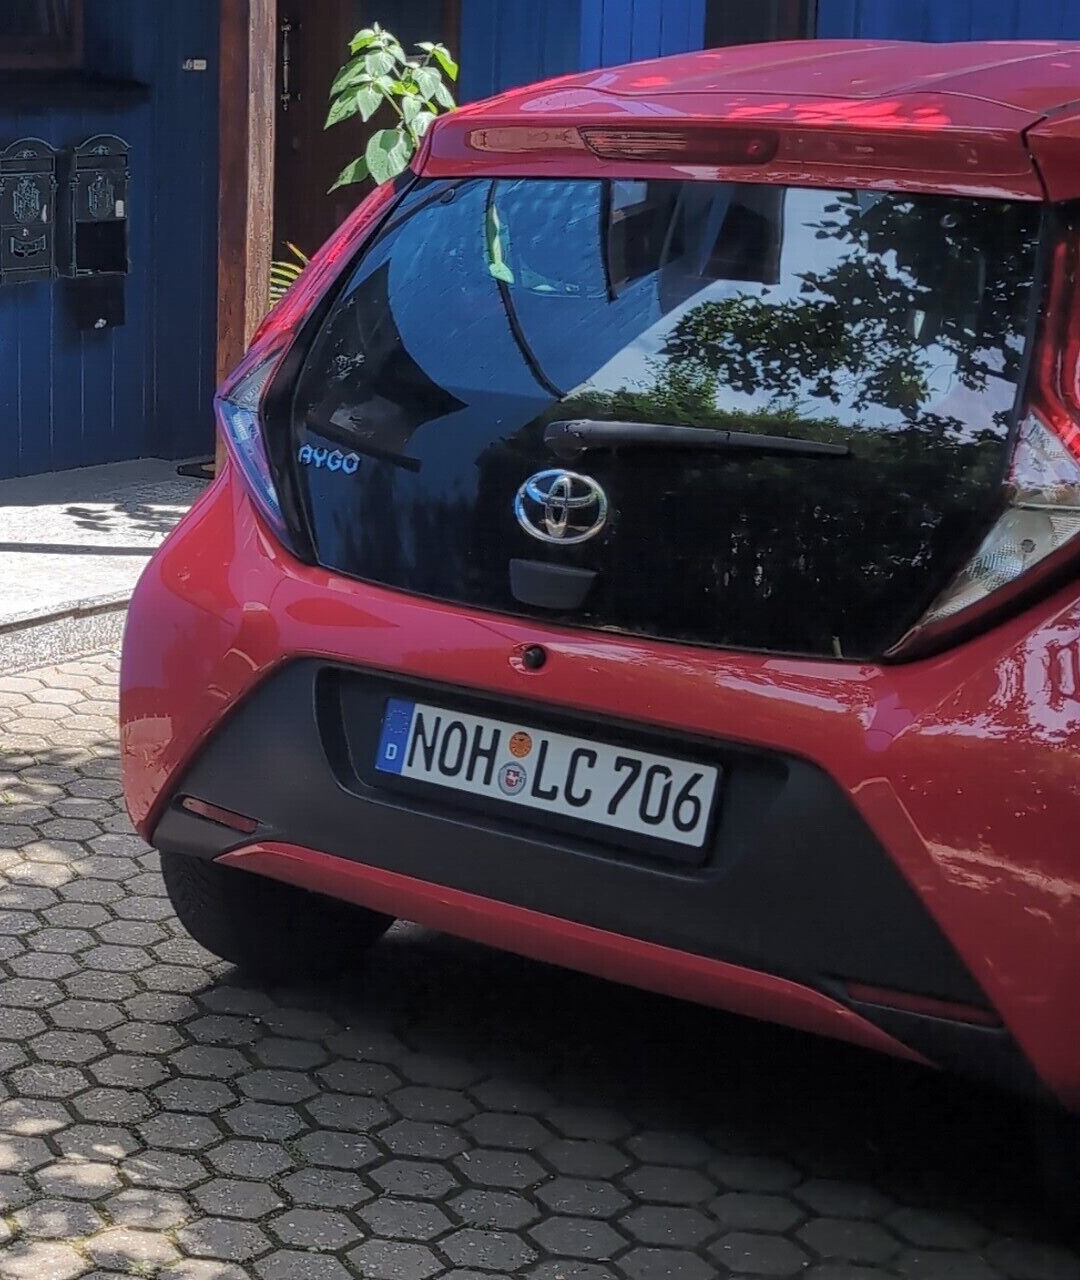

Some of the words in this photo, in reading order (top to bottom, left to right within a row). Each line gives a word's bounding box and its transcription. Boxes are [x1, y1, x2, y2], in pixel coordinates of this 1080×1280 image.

[298, 443, 361, 474] AYGO
[385, 744, 398, 760] D
[407, 712, 501, 786] NOH
[531, 739, 598, 807] LC
[607, 755, 705, 832] 706
